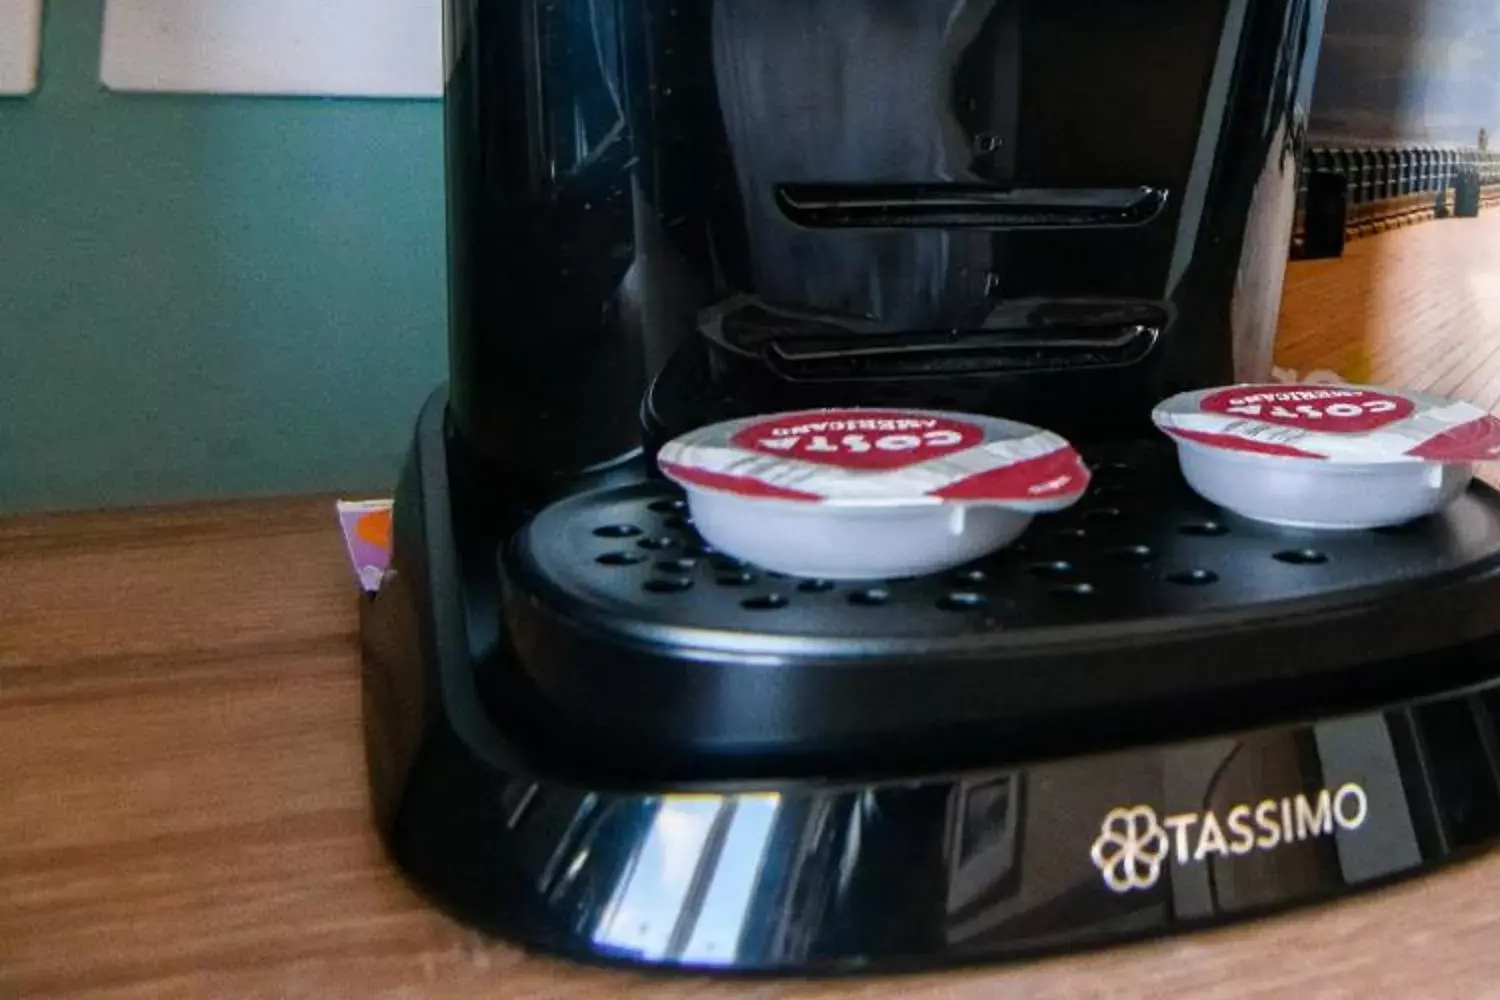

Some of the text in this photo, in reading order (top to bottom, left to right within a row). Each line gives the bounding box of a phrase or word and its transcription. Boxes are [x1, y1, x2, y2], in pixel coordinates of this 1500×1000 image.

[1225, 398, 1397, 421] COSTA
[771, 418, 938, 436] AMERICANO
[758, 429, 963, 454] COSTA
[1163, 781, 1368, 866] TASSIMO
